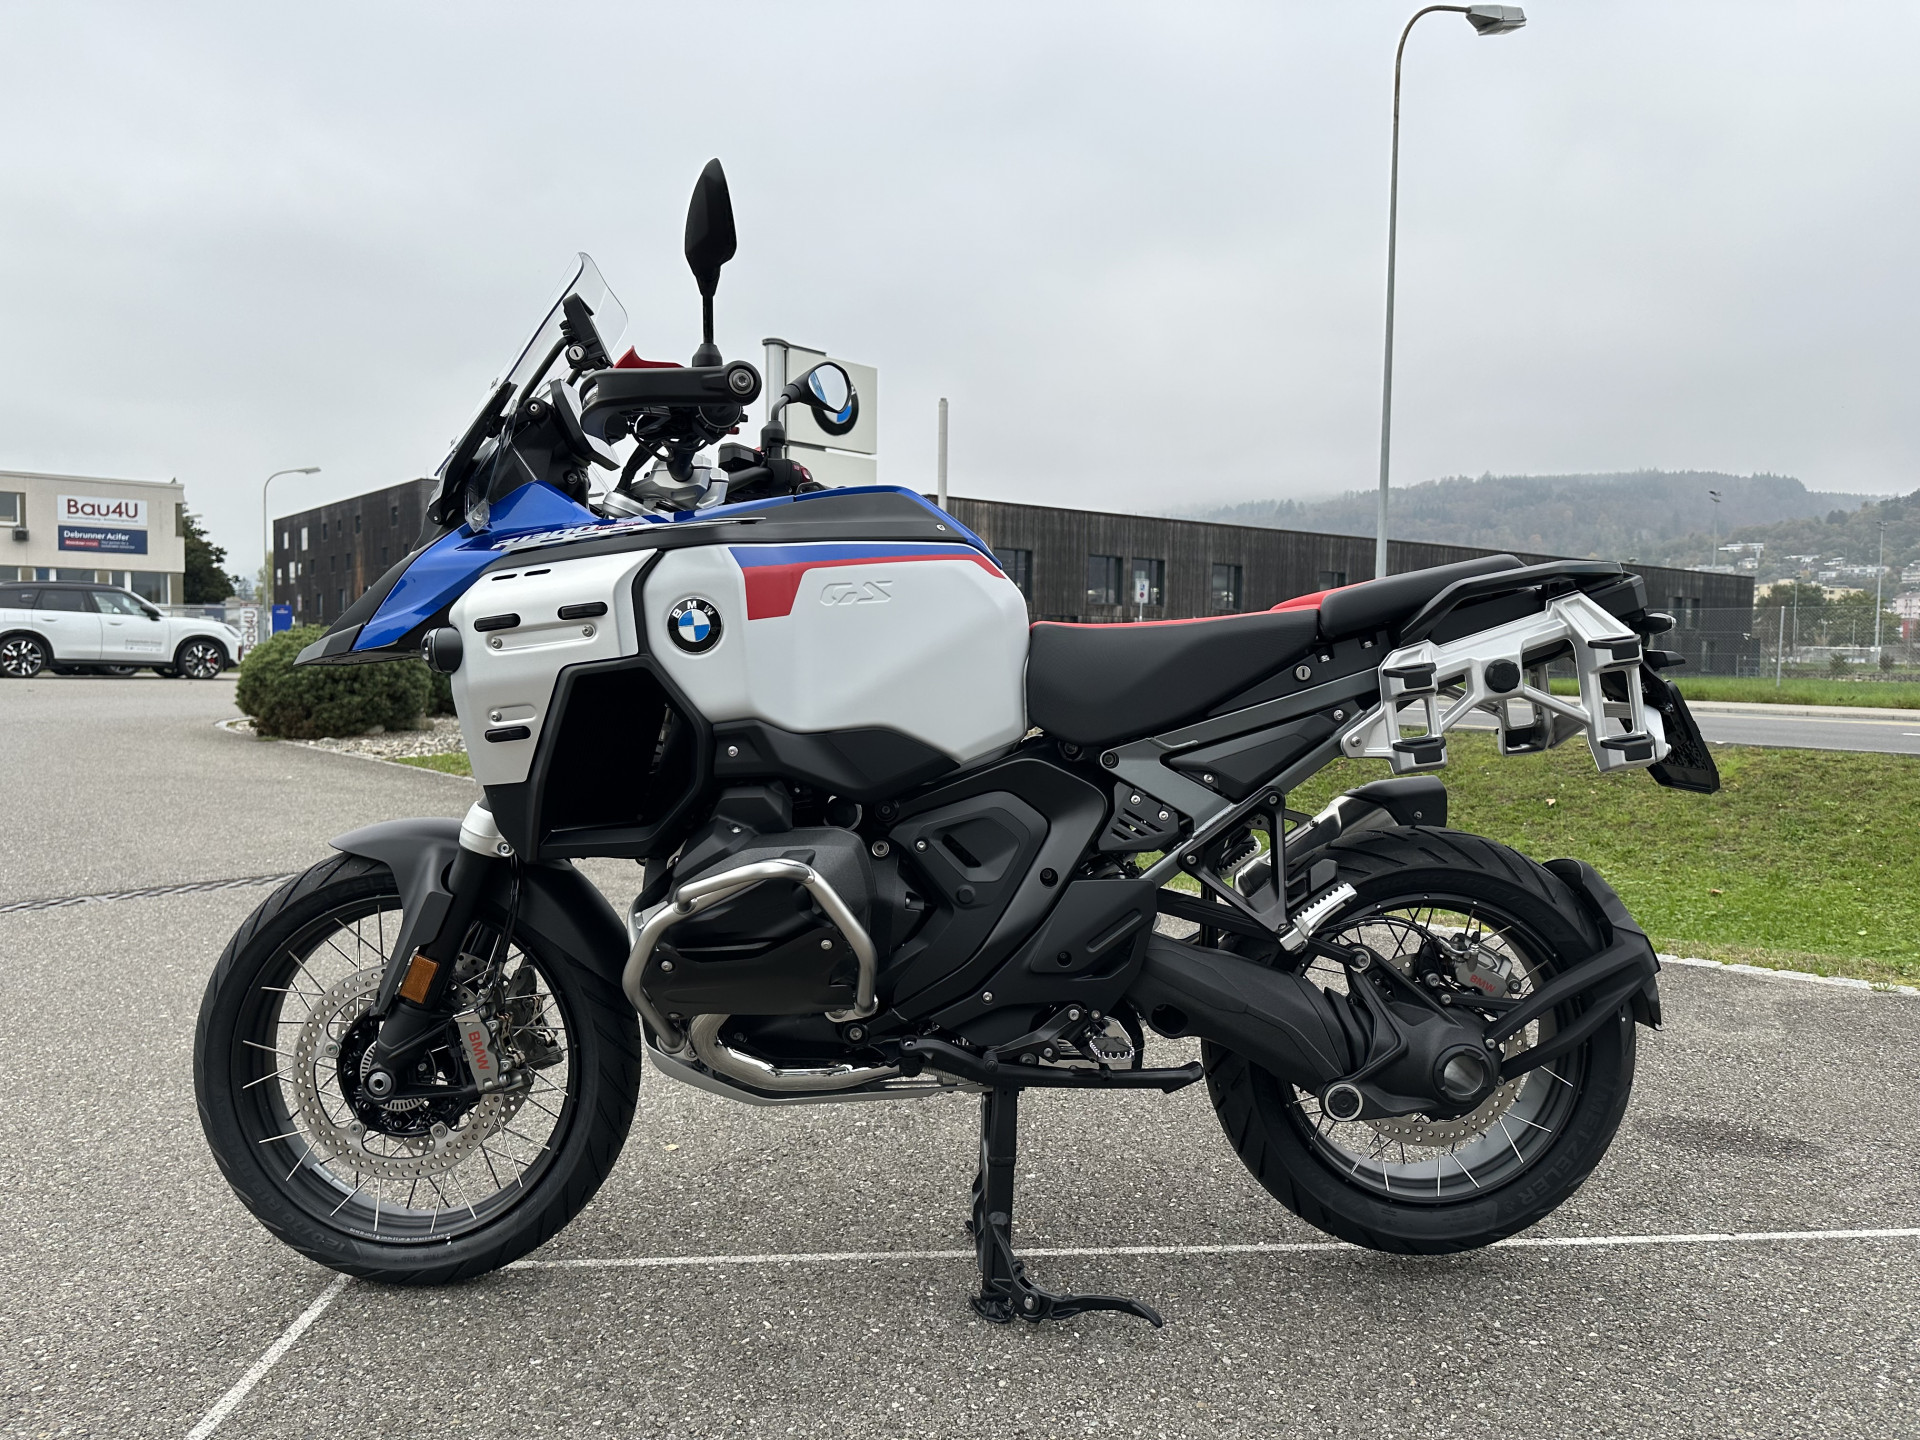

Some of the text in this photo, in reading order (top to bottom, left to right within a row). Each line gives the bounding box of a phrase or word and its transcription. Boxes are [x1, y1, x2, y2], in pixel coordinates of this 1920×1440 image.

[67, 498, 139, 519] Bau4U
[64, 530, 130, 541] Debrunner Acifer
[819, 580, 893, 606] GS
[671, 600, 716, 619] BMW
[244, 611, 257, 650] Bau4U
[1470, 974, 1496, 993] BMW
[468, 1031, 490, 1070] BMW
[1518, 1090, 1608, 1205] METZELER
